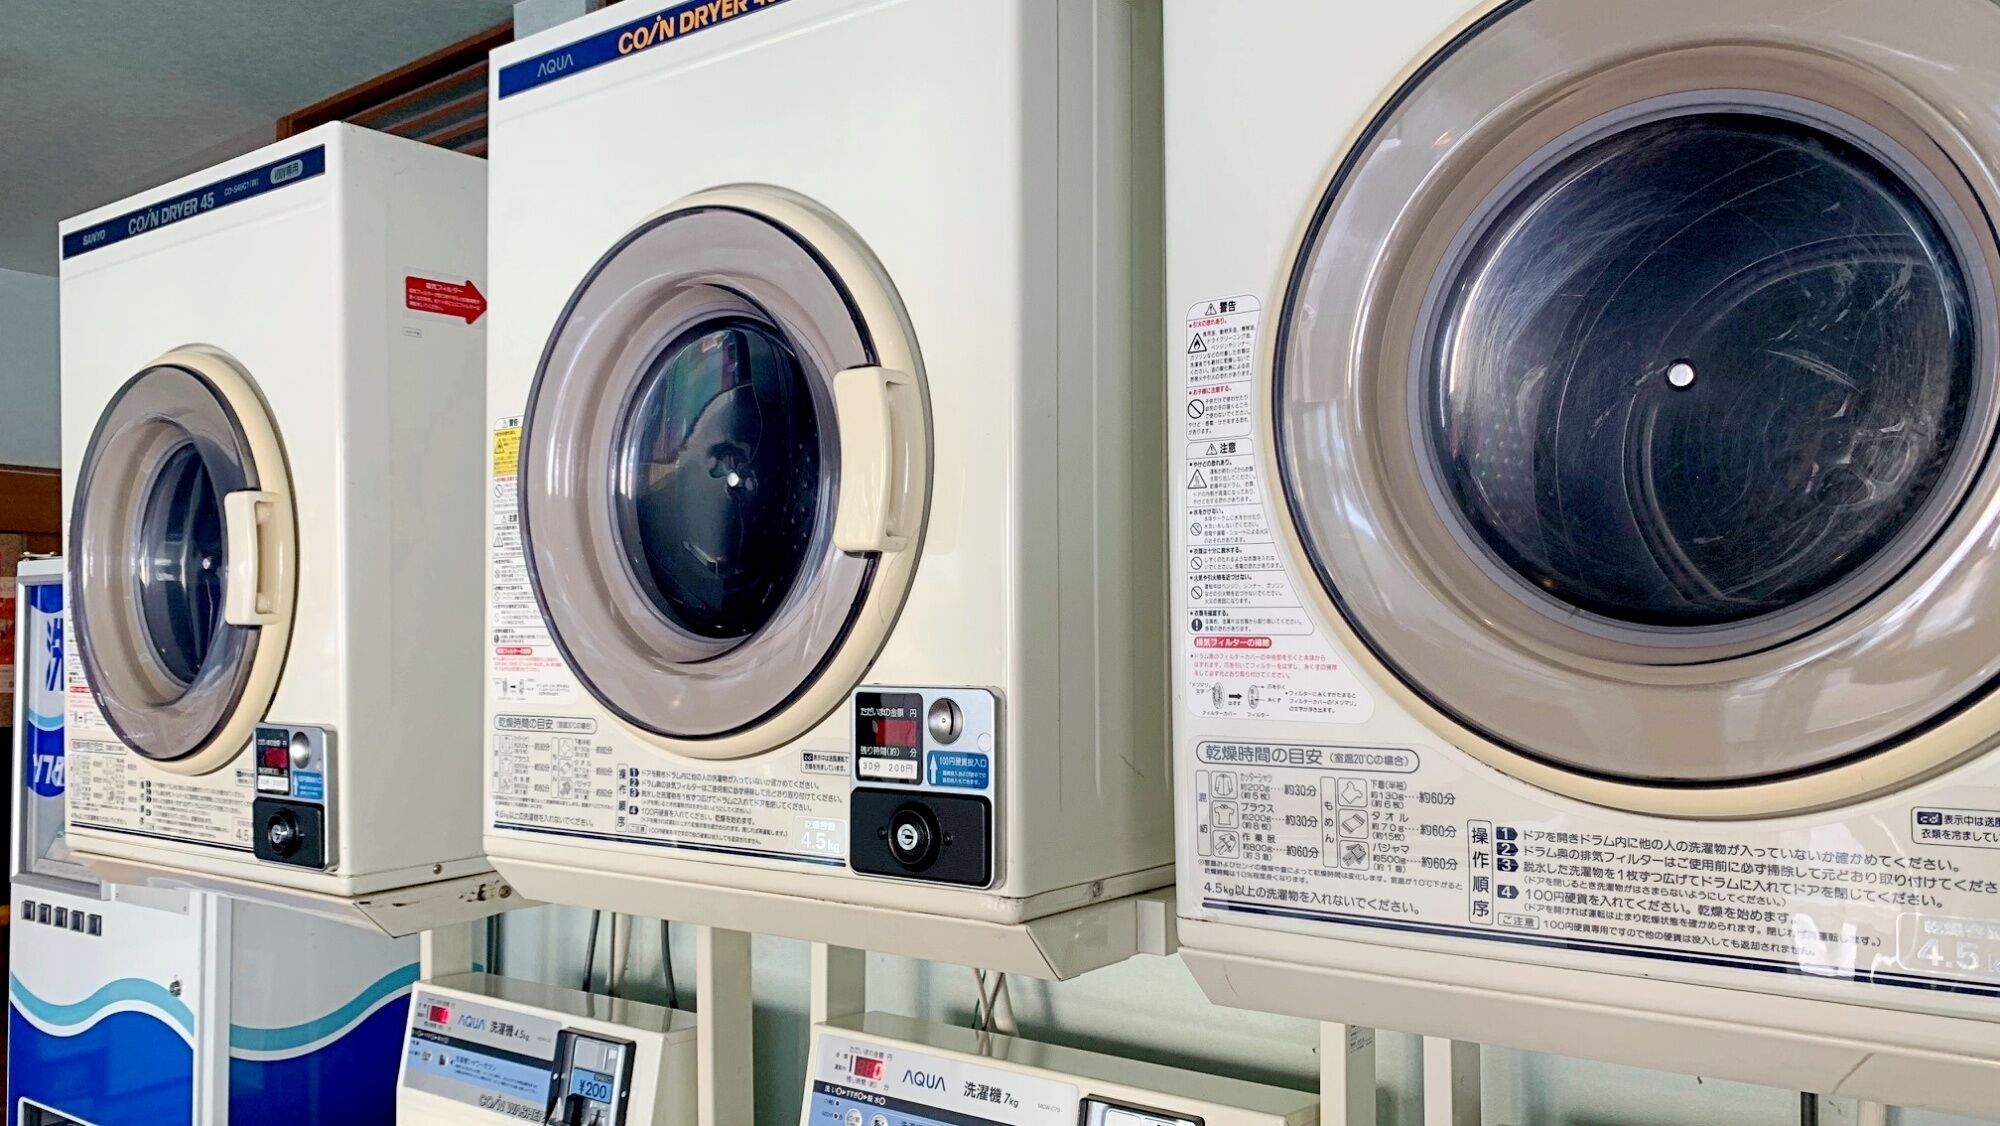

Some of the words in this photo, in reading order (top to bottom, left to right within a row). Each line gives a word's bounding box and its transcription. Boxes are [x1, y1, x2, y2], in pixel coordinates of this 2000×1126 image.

[537, 53, 574, 78] AQUA
[618, 14, 675, 55] COIN
[679, 0, 749, 35] DRYER
[82, 229, 106, 246] SANYO
[128, 208, 160, 235] COIN
[161, 197, 198, 224] DRYER
[200, 191, 215, 209] 45
[1220, 300, 1236, 313] 警告
[1220, 442, 1236, 454] 注意
[909, 708, 917, 718] 円
[909, 748, 917, 758] 分
[1205, 744, 1323, 765] 乾燥時間の目安
[888, 763, 913, 774] 200円
[1284, 784, 1317, 797] 約30分
[1419, 792, 1456, 806] 約60分
[1285, 814, 1318, 828] 約30分
[1324, 801, 1335, 844] もめん
[1420, 824, 1457, 838] 約60分
[801, 830, 826, 850] 4.5
[827, 839, 840, 853] kg
[1372, 843, 1410, 854] パジャマ
[1286, 845, 1319, 859] 約60分
[1501, 843, 1510, 856] 2
[1523, 829, 1960, 873] ドアを開きドラム内に他の人の洗濯物が入っていないか確かめてください。
[1421, 856, 1458, 871] 約60分
[1502, 859, 1512, 872] 3
[1471, 827, 1490, 918] 操作順序
[1501, 886, 1513, 899] 4
[1917, 938, 1979, 970] 4.5
[579, 1079, 607, 1099] ¥200
[902, 1069, 946, 1092] AQUA
[963, 1081, 1002, 1104] 洗濯機
[1003, 1093, 1019, 1109] 7kg
